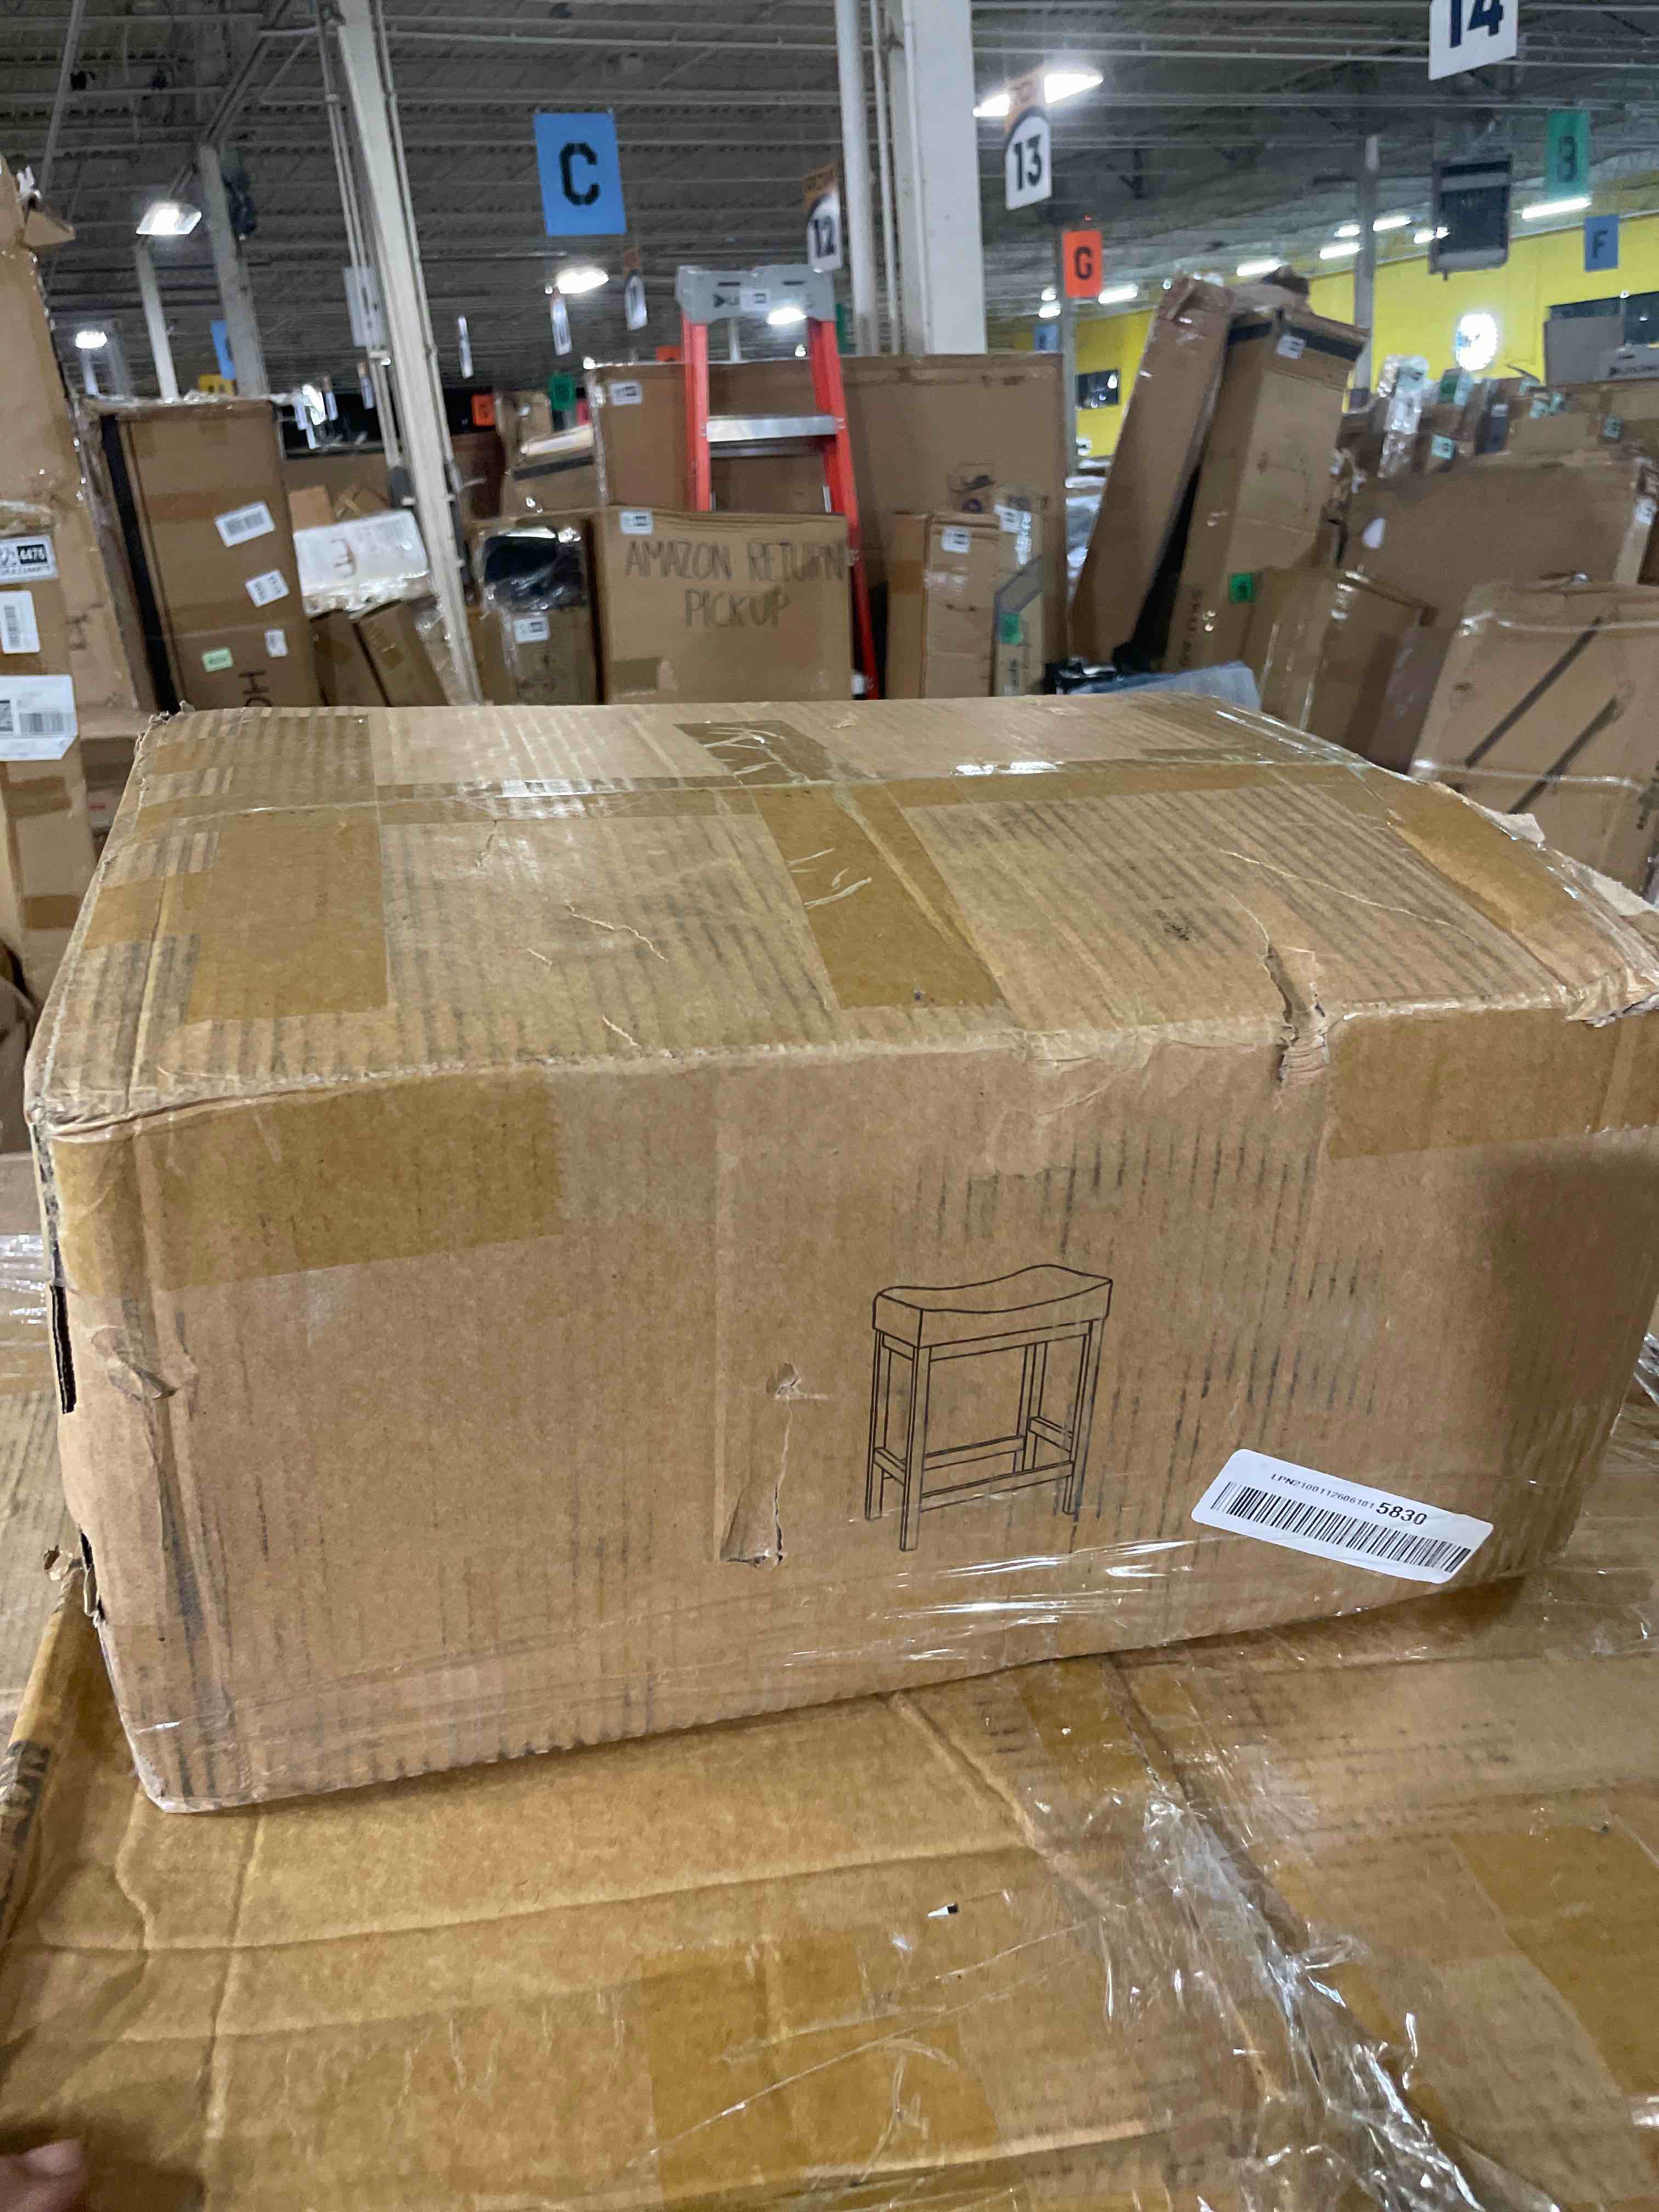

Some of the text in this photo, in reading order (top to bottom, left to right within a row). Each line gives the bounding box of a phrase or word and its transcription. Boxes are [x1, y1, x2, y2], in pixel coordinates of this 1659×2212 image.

[559, 142, 600, 205] C
[1013, 134, 1042, 190] 13
[814, 215, 835, 258] 12
[1592, 230, 1609, 259] F
[1074, 246, 1092, 280] G
[624, 540, 849, 582] AMAZON RETURN
[685, 588, 791, 627] PICKUP
[1376, 1502, 1428, 1526] 5830
